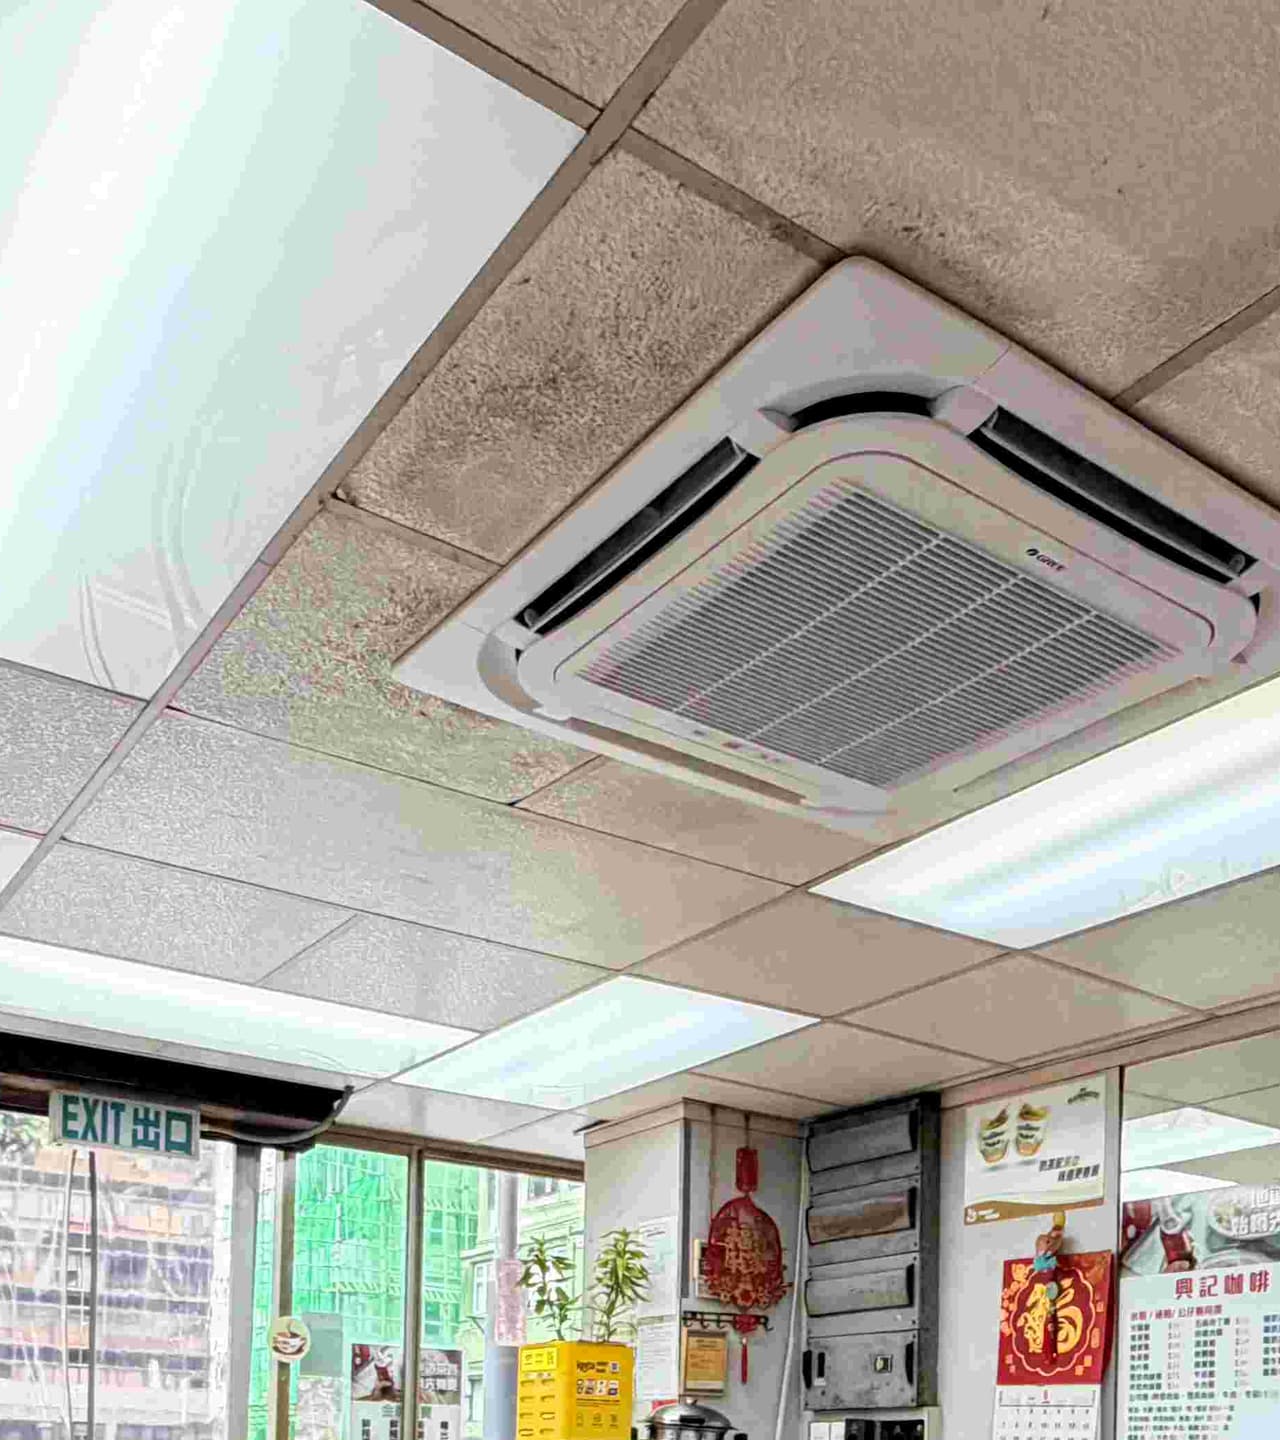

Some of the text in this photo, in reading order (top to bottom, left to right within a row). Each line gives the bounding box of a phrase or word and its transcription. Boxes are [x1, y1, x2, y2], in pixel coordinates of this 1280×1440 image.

[62, 1094, 193, 1156] EXIT 出口
[1175, 1269, 1271, 1299] 興記咖啡
